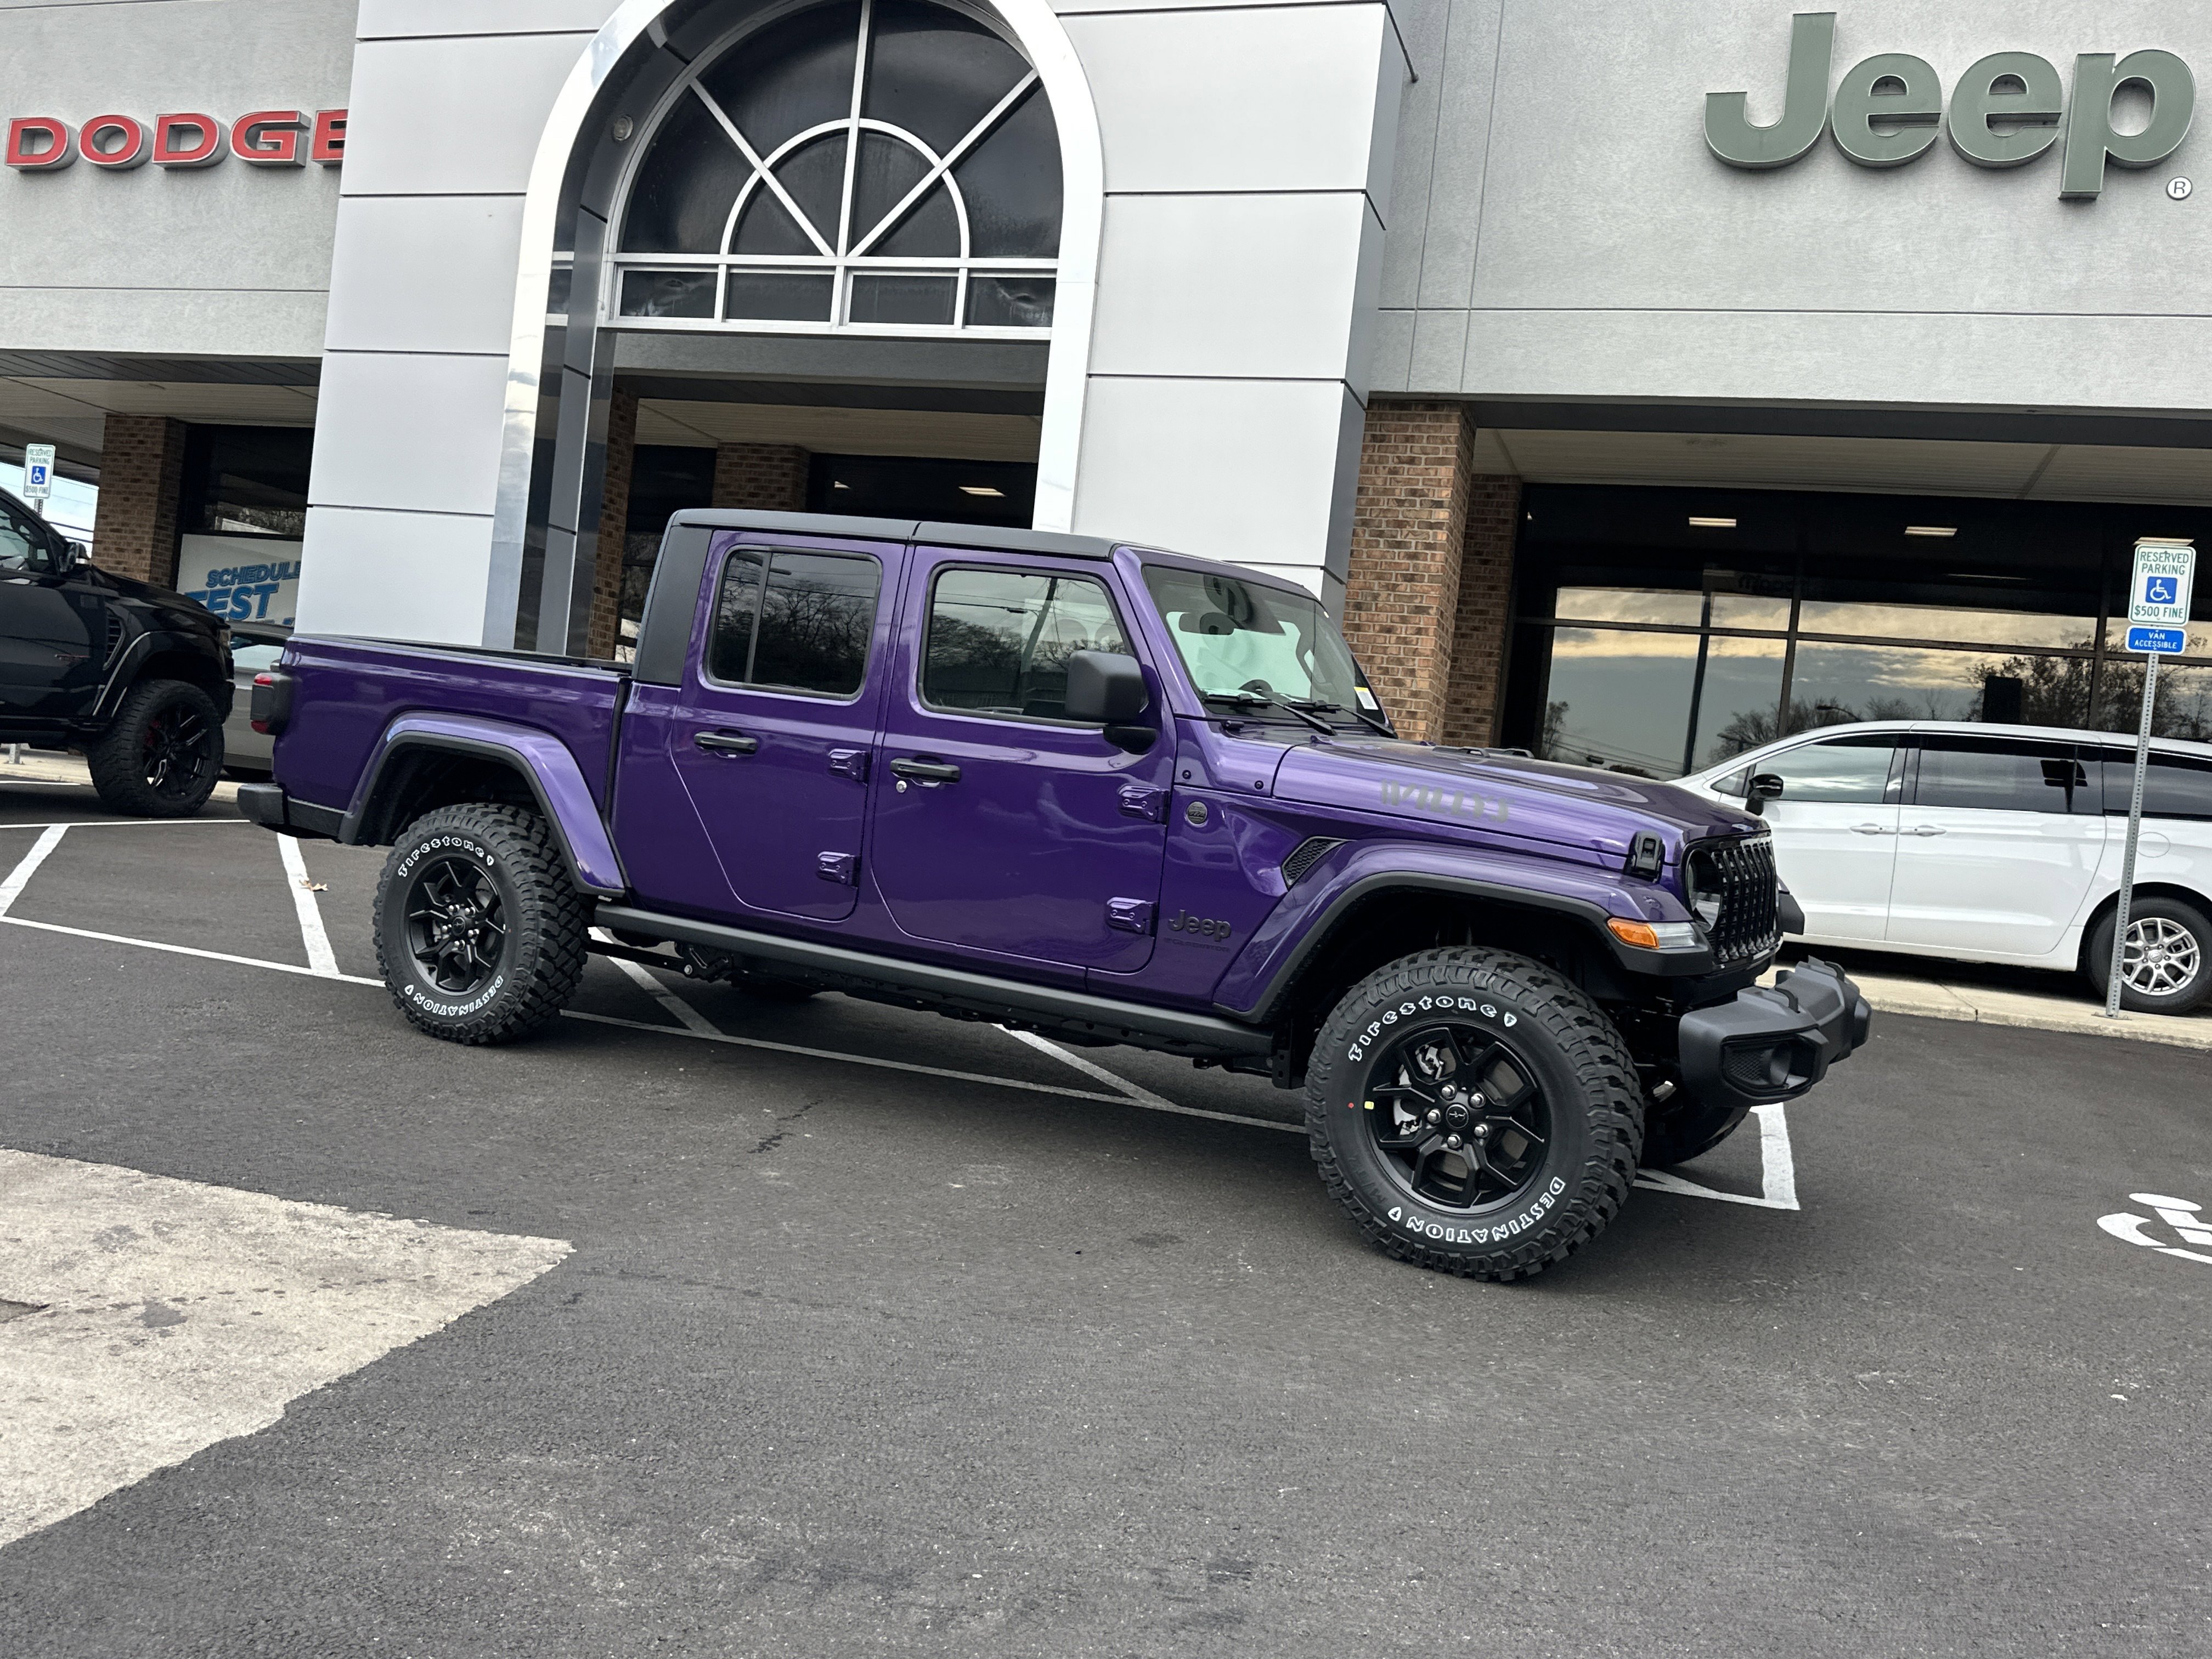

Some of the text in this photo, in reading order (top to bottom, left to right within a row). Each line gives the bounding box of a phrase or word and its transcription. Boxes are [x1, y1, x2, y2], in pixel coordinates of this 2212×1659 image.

[1704, 12, 2196, 199] Jeep
[6, 110, 348, 168] DODGE
[30, 456, 50, 465] PARKING
[2140, 551, 2189, 563] RESERVED
[2141, 563, 2186, 575] PARKING
[206, 560, 301, 588] SCHEDULE
[2134, 605, 2184, 618] $500 FINE
[2134, 640, 2177, 649] ACCESSIBLE
[1168, 909, 1232, 942] Jeep
[413, 975, 504, 1016] DESTINATION
[1406, 1176, 1566, 1244] DESTINATION
